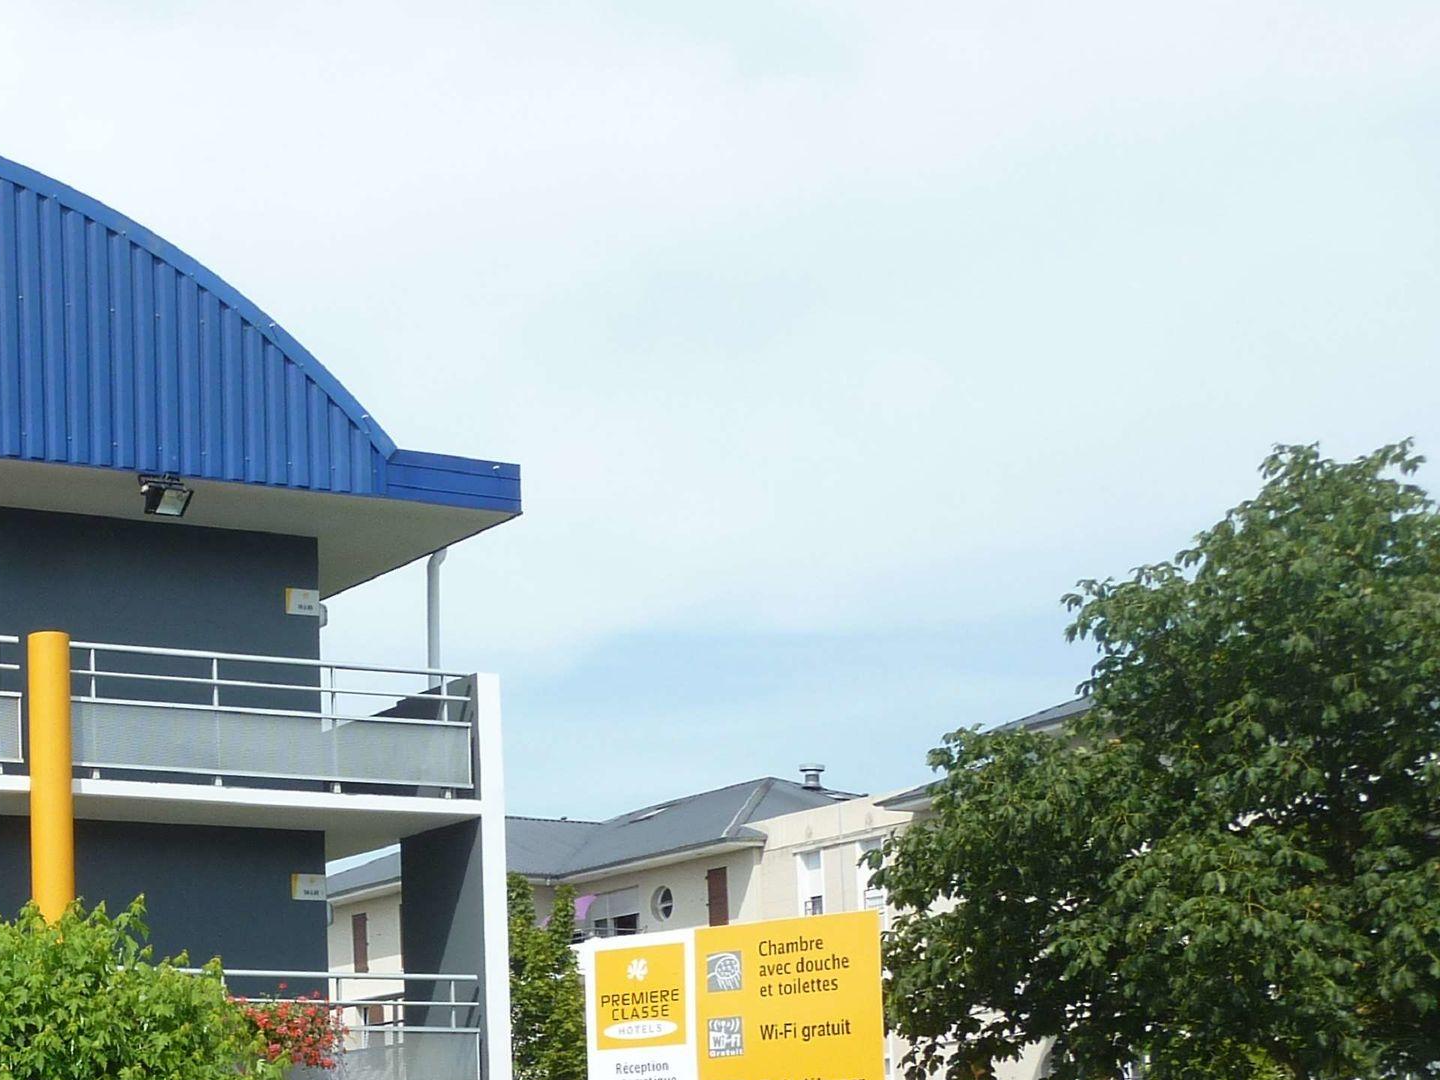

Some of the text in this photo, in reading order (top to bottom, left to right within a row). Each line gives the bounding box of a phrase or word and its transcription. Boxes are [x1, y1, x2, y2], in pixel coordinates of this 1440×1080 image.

[758, 935, 824, 957] Chambre
[759, 953, 850, 977] avec douche
[759, 977, 839, 997] et toilettes
[600, 988, 680, 1008] PREMIERE
[611, 1004, 670, 1021] CLASSE
[759, 1019, 851, 1041] Wi-Fi gratuit
[615, 1061, 670, 1076] Réception
